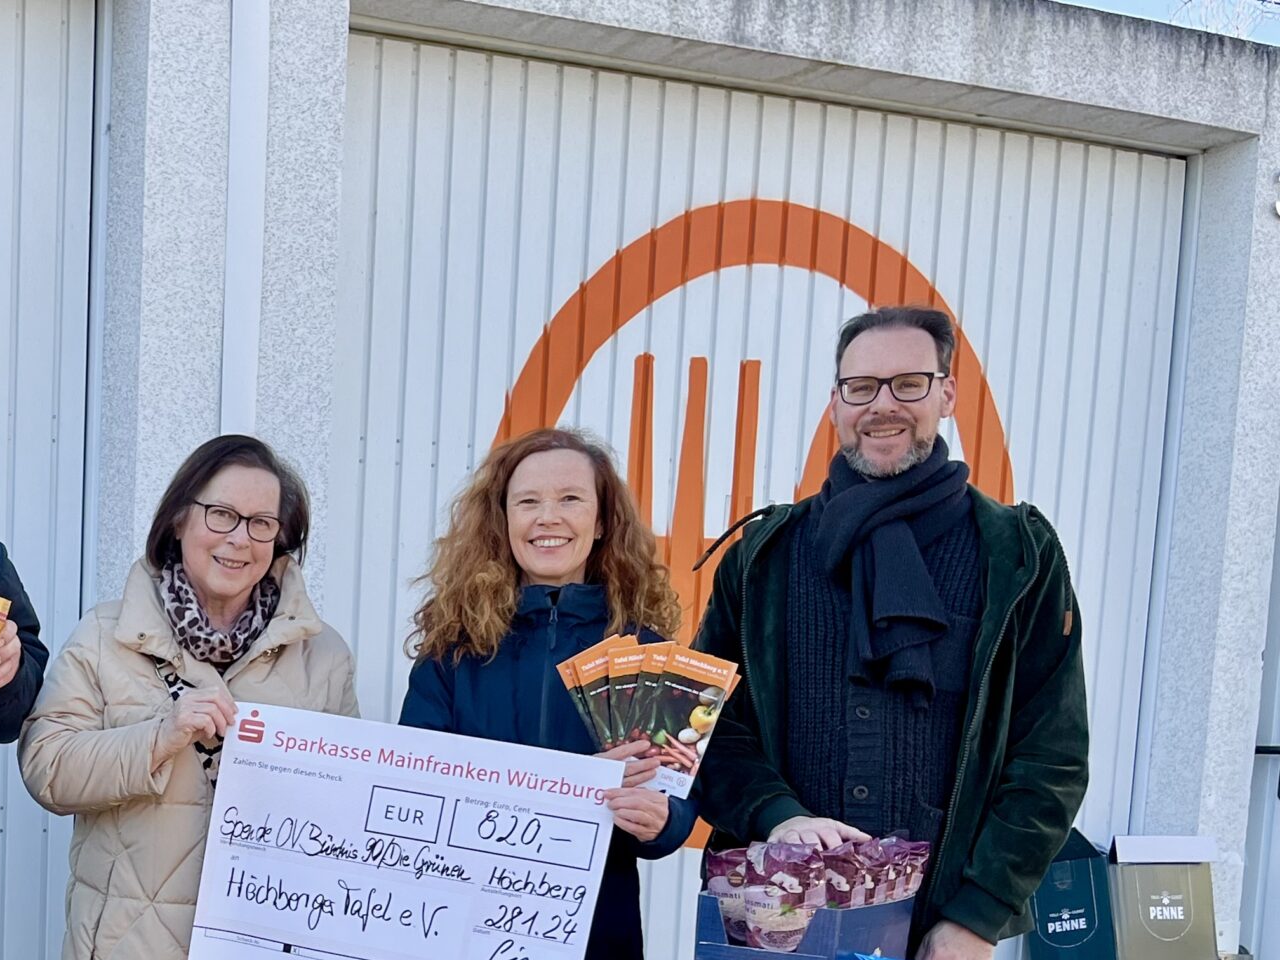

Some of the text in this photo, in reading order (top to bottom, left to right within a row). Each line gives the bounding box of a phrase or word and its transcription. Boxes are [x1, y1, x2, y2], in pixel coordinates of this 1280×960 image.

[232, 756, 257, 768] Zahlen
[270, 764, 292, 775] gegen
[293, 766, 318, 778] diesen
[319, 771, 344, 783] Scheck
[273, 730, 372, 763] Sparkasse
[377, 747, 501, 785] Mainfranken
[506, 768, 606, 806] Würzburg
[384, 804, 426, 827] EUR
[512, 804, 532, 815] Cent
[413, 845, 473, 881] Grünen
[487, 865, 588, 918] Höchberg
[337, 879, 393, 933] Tafel
[1149, 906, 1185, 920] PENNE
[1047, 917, 1088, 934] PENNE
